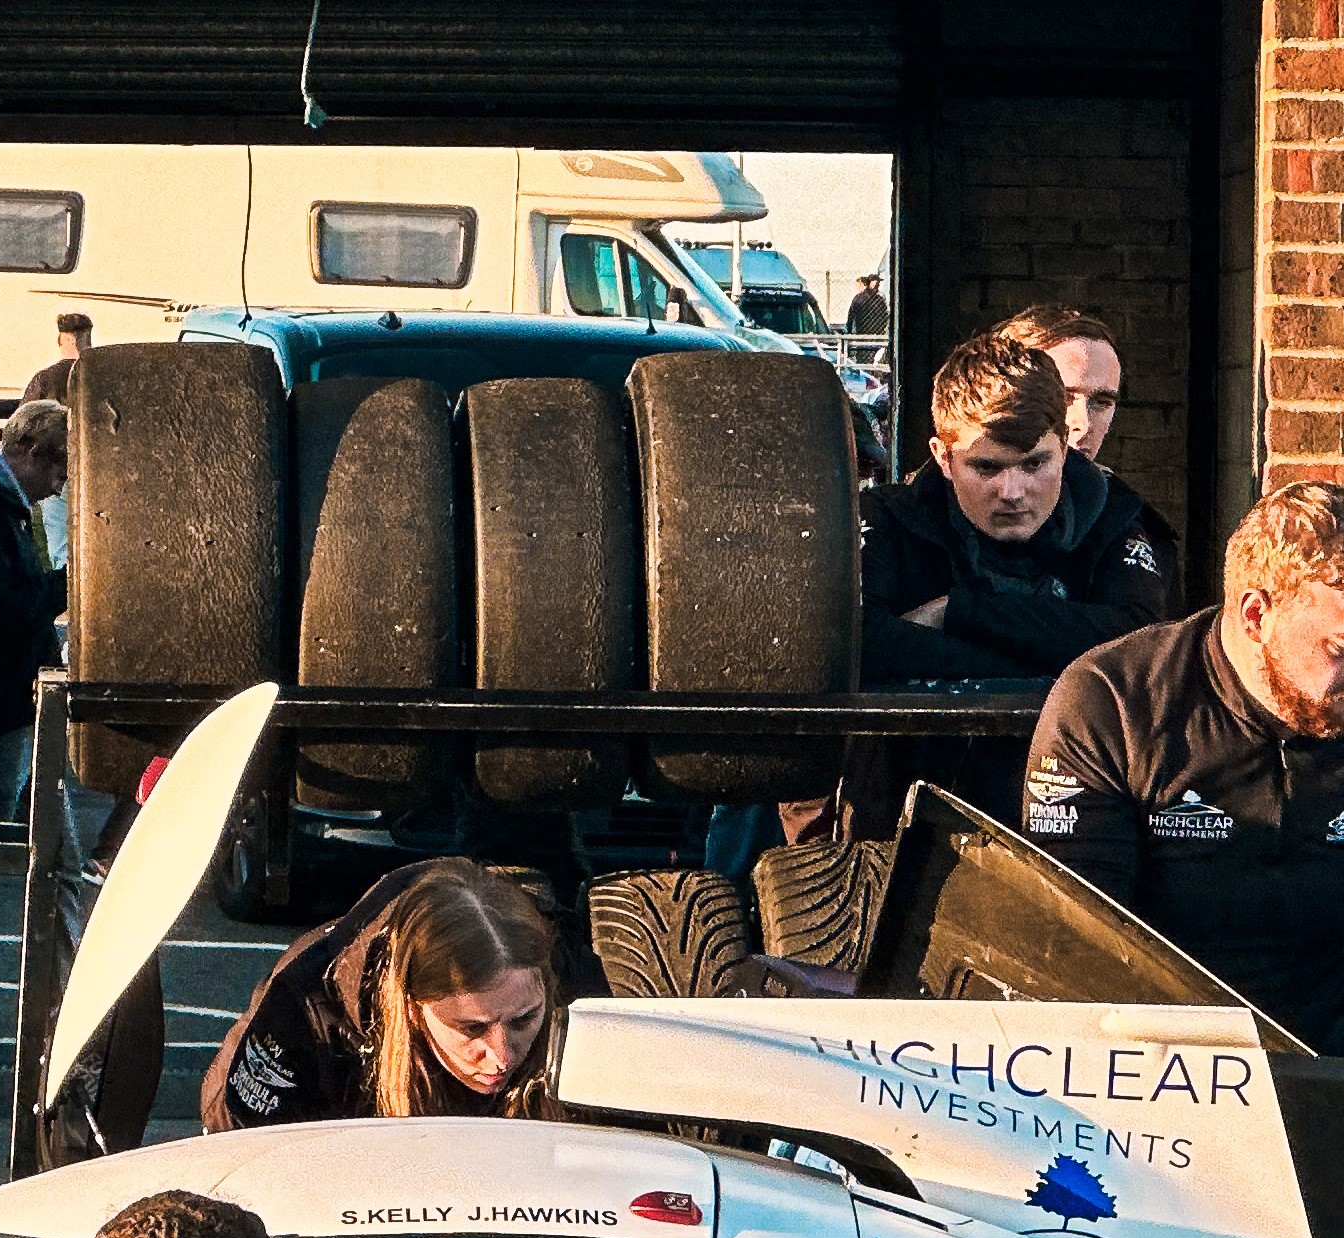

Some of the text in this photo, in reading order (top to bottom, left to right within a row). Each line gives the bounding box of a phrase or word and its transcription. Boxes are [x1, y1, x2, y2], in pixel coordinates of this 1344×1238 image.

[1030, 802, 1079, 820] FORMULA
[1030, 818, 1077, 834] STUDENT
[1148, 814, 1234, 830] HIGHCLEAR
[860, 1075, 1194, 1169] INVESTMENTS
[341, 1207, 619, 1227] S.KELLY J.HAWKINS
